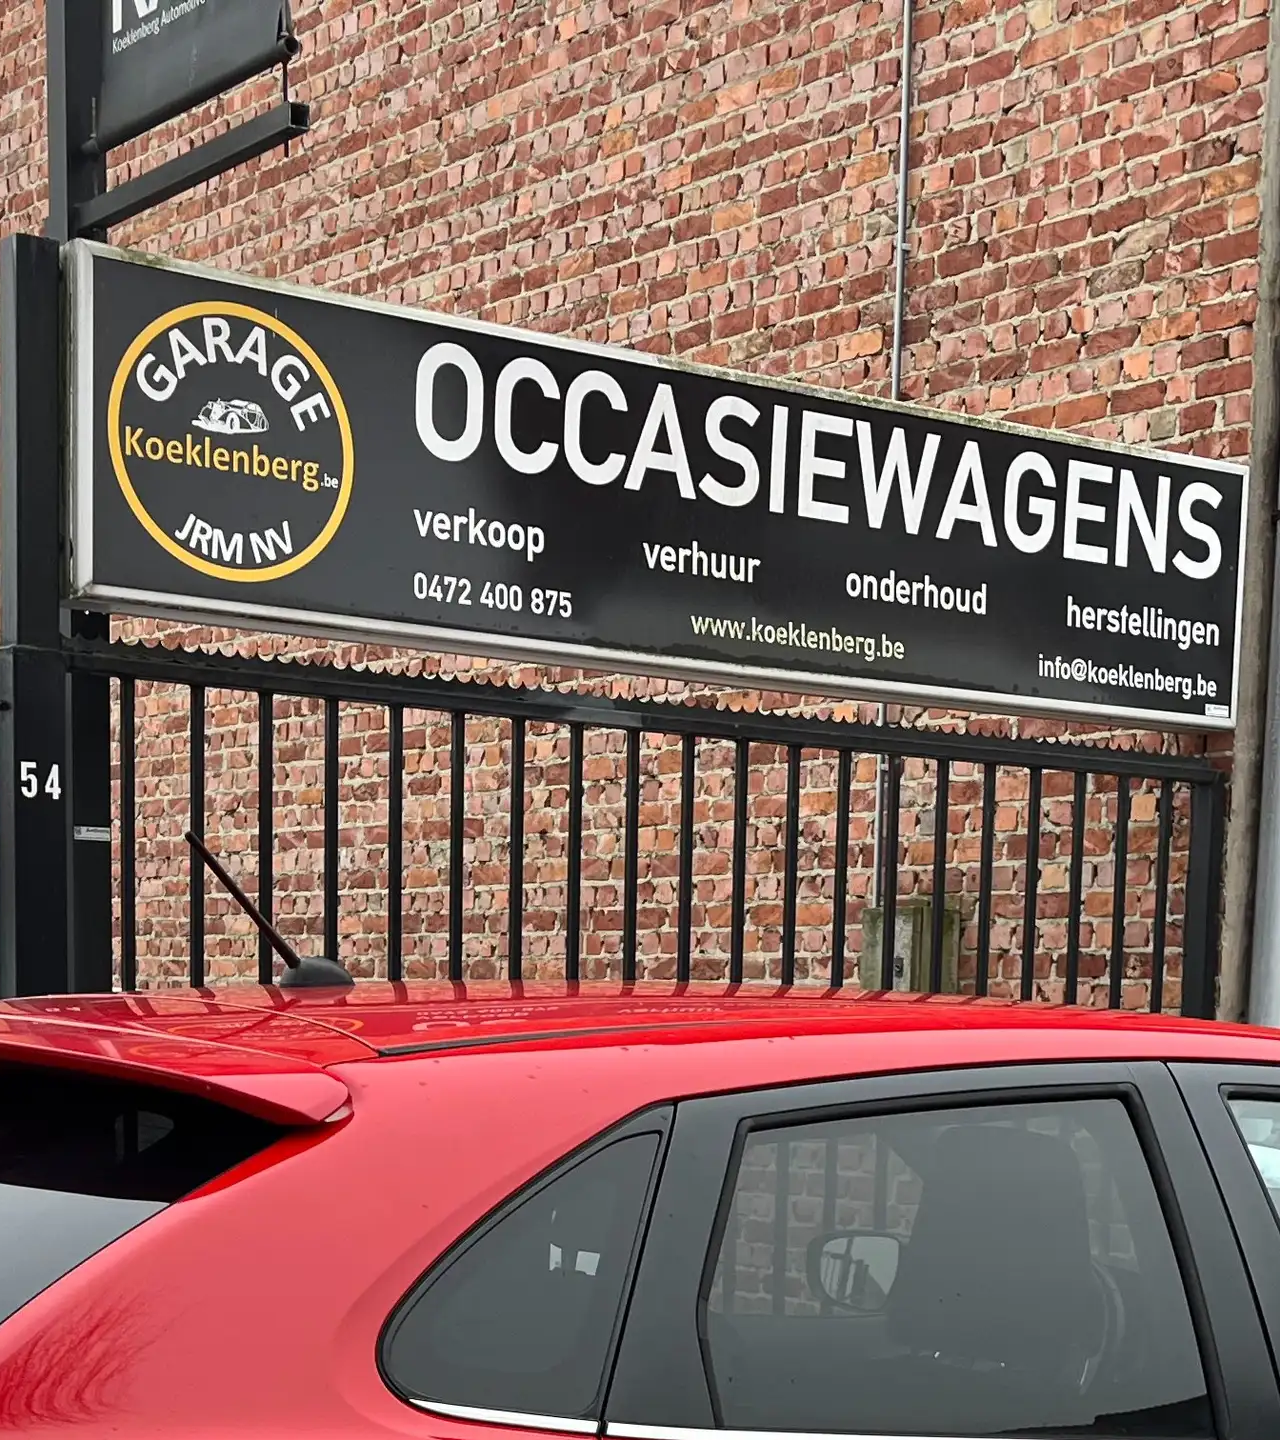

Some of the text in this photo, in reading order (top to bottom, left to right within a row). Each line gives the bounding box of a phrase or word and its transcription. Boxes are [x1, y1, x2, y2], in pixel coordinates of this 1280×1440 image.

[136, 317, 332, 432] GARAGE
[415, 342, 1223, 580] OCCASIEWAGENS
[174, 513, 294, 565] JRM NV
[413, 508, 545, 563] verkoop
[642, 541, 761, 583] verhuur
[413, 572, 572, 618] 0472 400 875
[845, 569, 988, 615] onderhoud
[690, 615, 905, 662] www.koeklenberg.be
[1066, 595, 1220, 651] herstellingen
[1038, 653, 1217, 700] info@koeklenberg.be
[20, 761, 62, 800] 54
